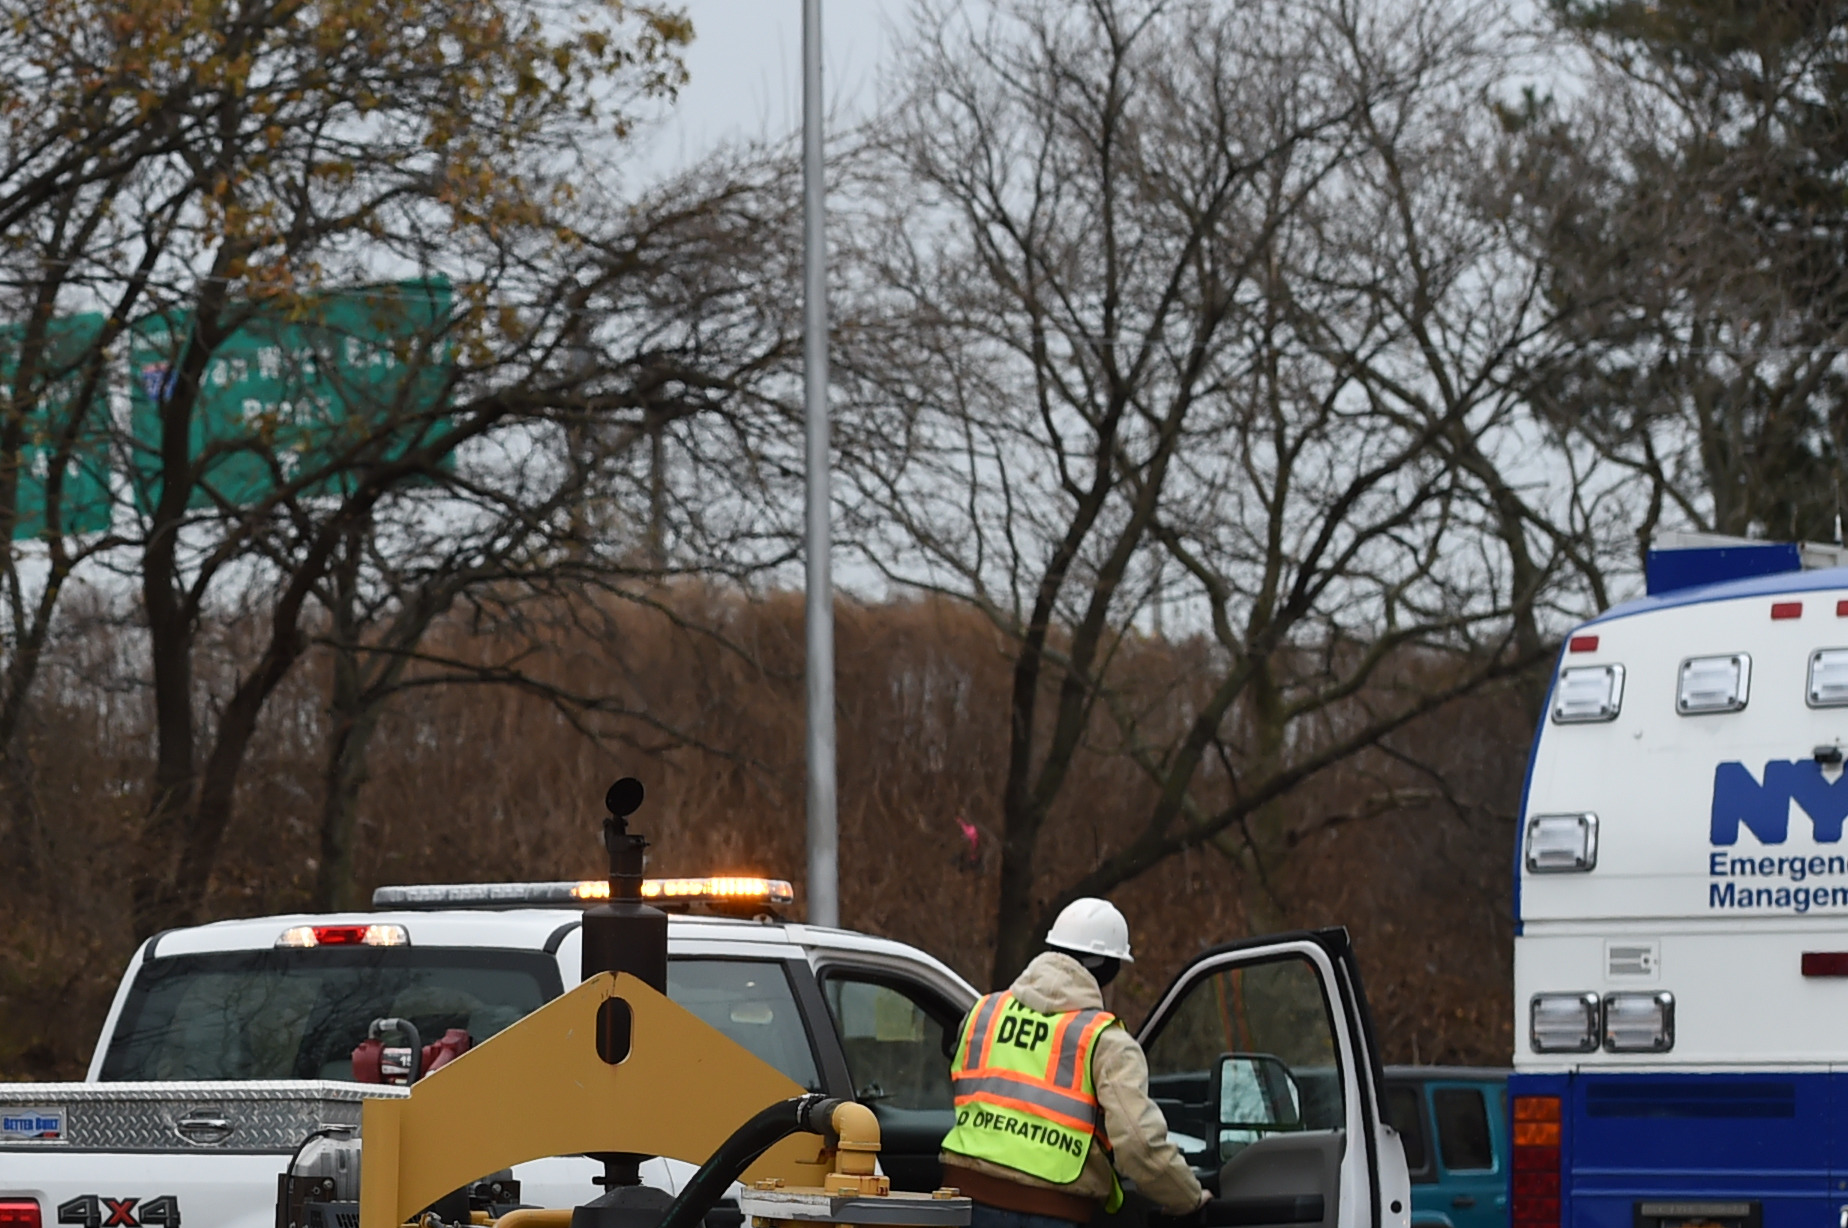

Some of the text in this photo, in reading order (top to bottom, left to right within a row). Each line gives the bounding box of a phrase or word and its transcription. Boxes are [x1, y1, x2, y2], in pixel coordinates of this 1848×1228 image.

[1710, 852, 1848, 881] Emergen
[997, 1015, 1049, 1051] DEP
[973, 1111, 1083, 1157] OPERATIONS
